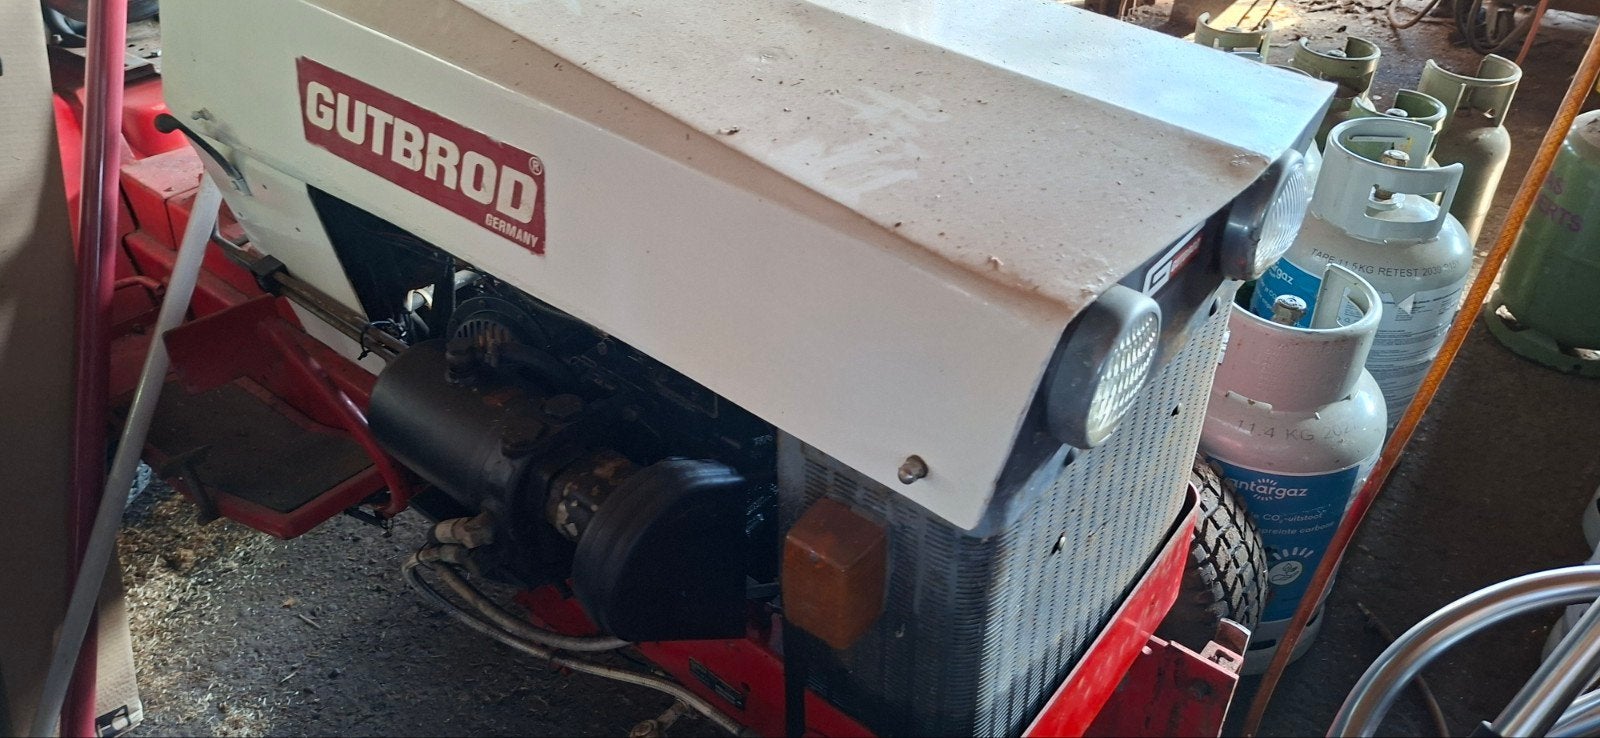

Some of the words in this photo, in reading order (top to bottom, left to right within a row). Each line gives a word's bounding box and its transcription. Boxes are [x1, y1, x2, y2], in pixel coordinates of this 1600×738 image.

[305, 80, 538, 224] GUTBROD
[485, 213, 539, 248] GERMANY
[1377, 266, 1419, 278] RETEST
[1285, 428, 1315, 441] KG
